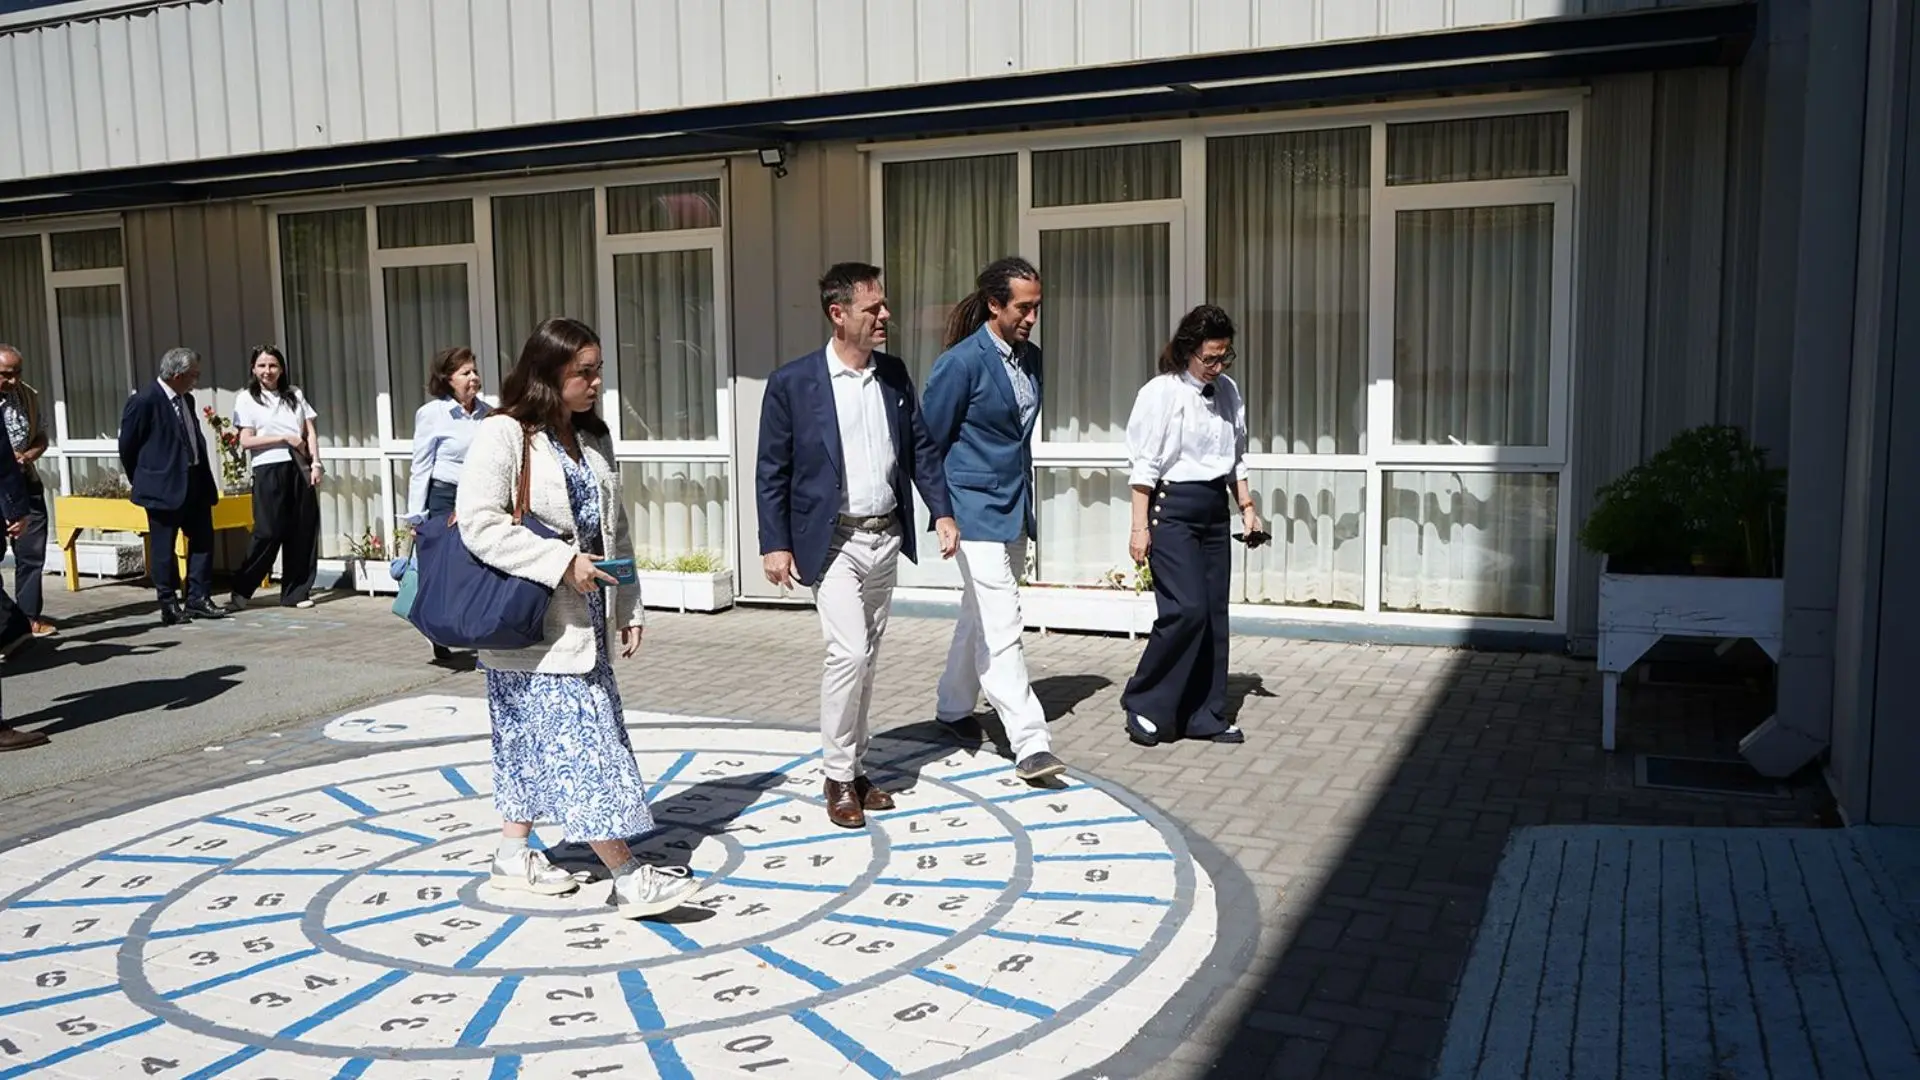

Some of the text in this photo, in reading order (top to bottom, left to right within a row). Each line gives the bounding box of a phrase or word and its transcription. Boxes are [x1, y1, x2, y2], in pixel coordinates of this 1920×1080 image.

[254, 806, 317, 823] 20
[909, 816, 968, 833] 27
[166, 835, 228, 851] 19
[1075, 832, 1100, 846] 5
[303, 843, 370, 860] 37
[916, 852, 988, 870] 28
[763, 854, 835, 869] 42
[81, 874, 153, 889] 18
[207, 893, 285, 910] 36
[362, 886, 442, 906] 46
[883, 892, 970, 911] 29
[1055, 910, 1085, 926] 7
[22, 918, 101, 939] 17
[413, 917, 482, 948] 45
[564, 923, 610, 949] 44
[188, 936, 275, 966] 35
[822, 931, 895, 953] 30
[998, 953, 1034, 972] 8
[250, 974, 339, 1008] 34
[692, 968, 760, 1002] 31
[380, 993, 457, 1031] 33
[546, 986, 598, 1026] 32
[724, 1035, 789, 1072] 10
